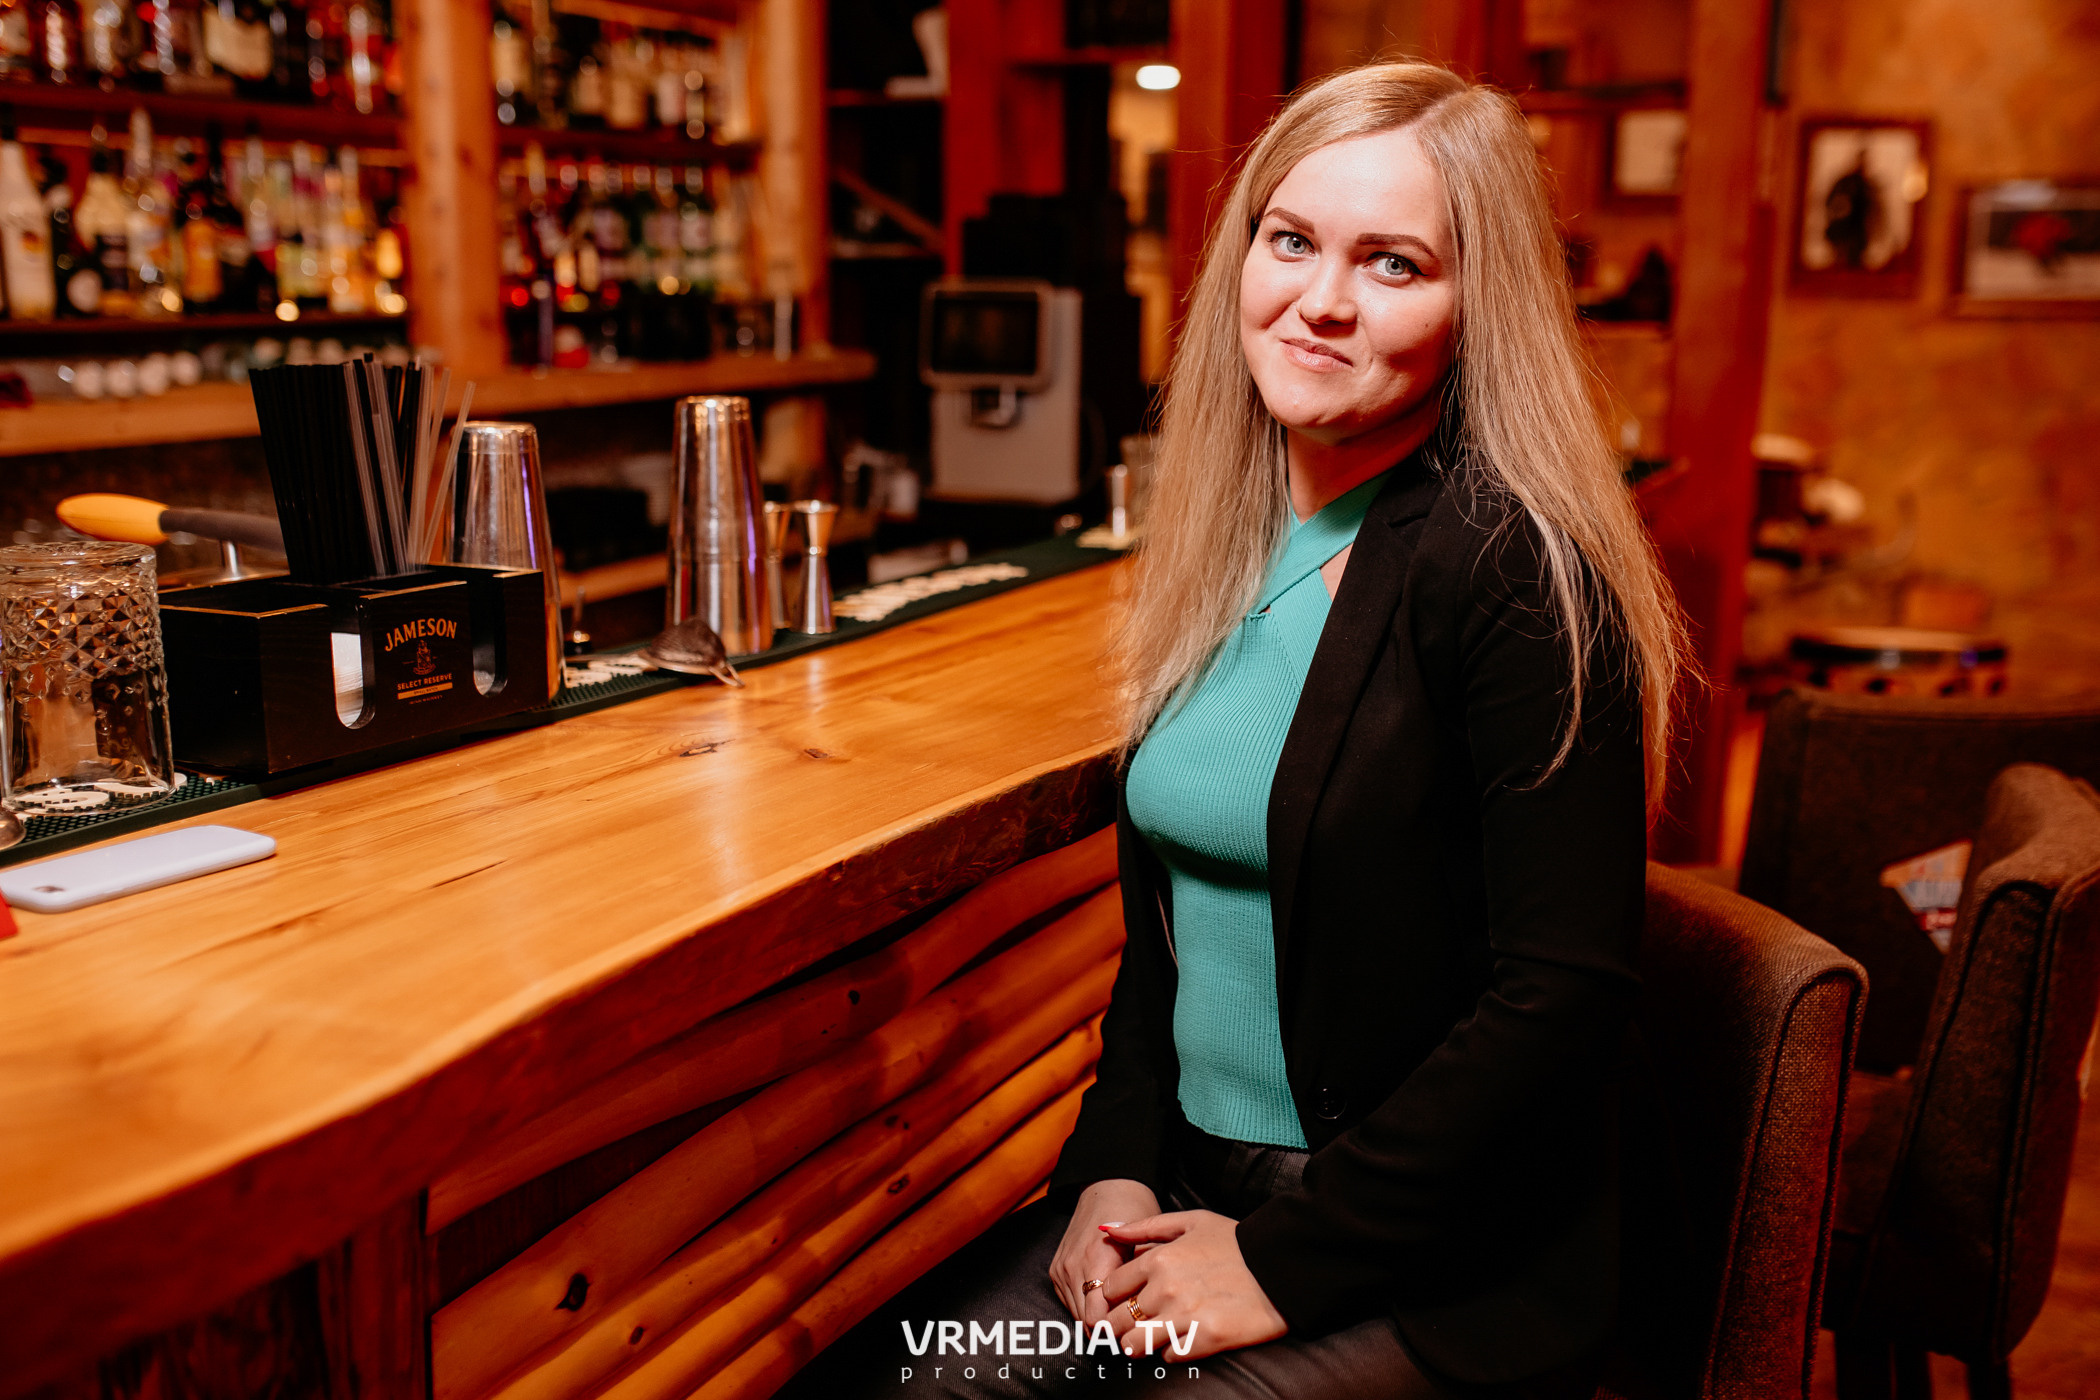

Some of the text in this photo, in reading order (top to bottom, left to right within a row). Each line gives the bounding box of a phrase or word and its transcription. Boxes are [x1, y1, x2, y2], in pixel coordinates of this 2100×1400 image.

[385, 618, 457, 651] JAMESON
[397, 673, 452, 690] SELECT RESERVE
